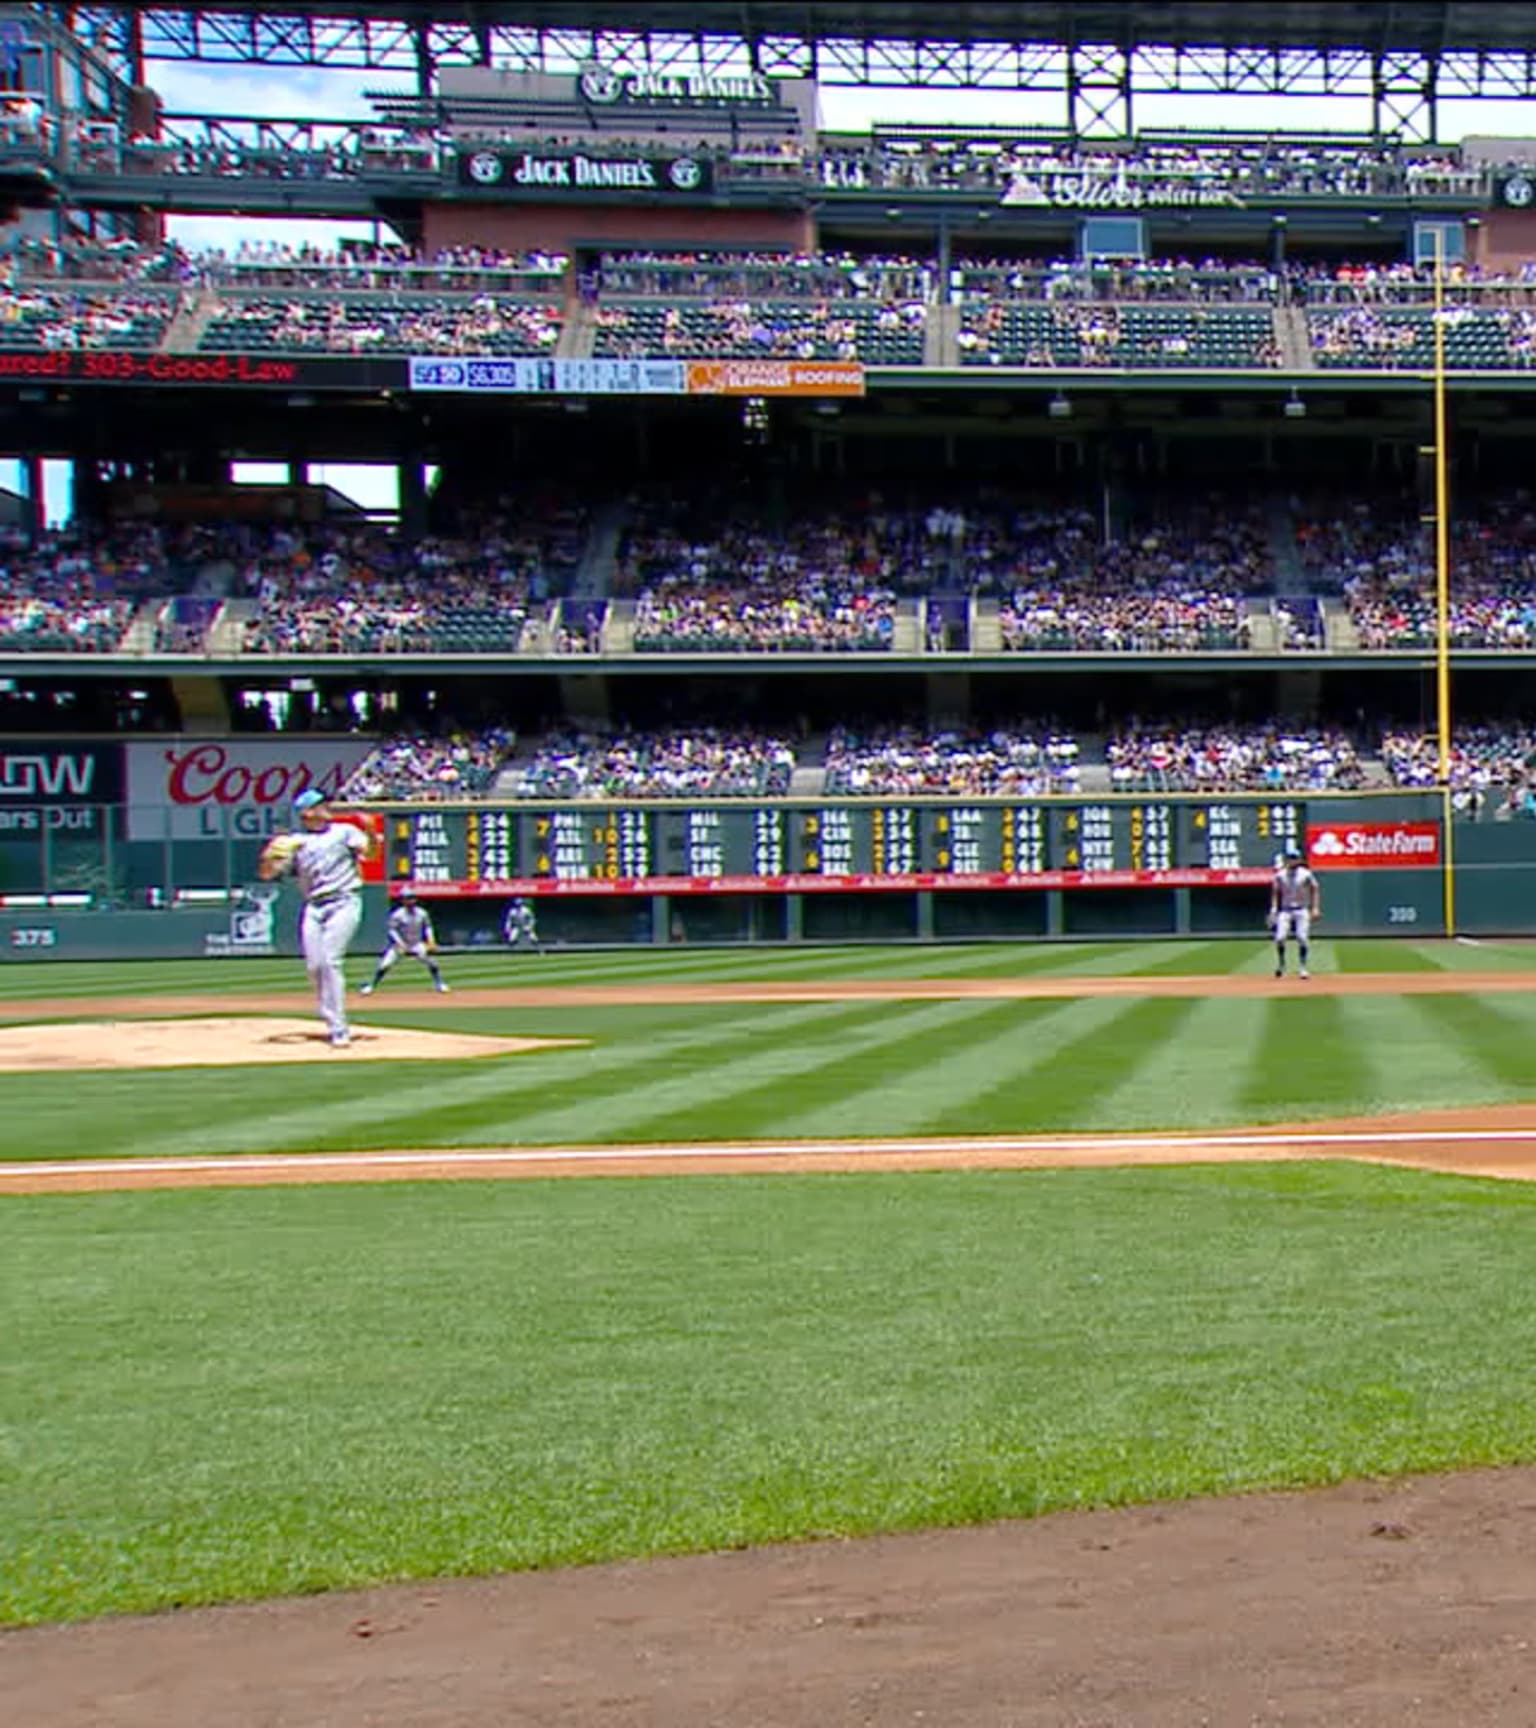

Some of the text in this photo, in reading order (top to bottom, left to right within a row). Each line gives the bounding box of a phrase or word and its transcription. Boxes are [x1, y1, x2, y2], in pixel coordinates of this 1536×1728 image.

[626, 75, 684, 100] JACK
[514, 154, 570, 185] JACK
[574, 155, 658, 187] DANIEL'S
[82, 352, 295, 381] 303-Good-Law
[690, 812, 721, 827] MIL
[953, 809, 983, 823] LAA
[690, 827, 709, 843] SF
[822, 826, 852, 841] CIN
[12, 929, 55, 946] 375
